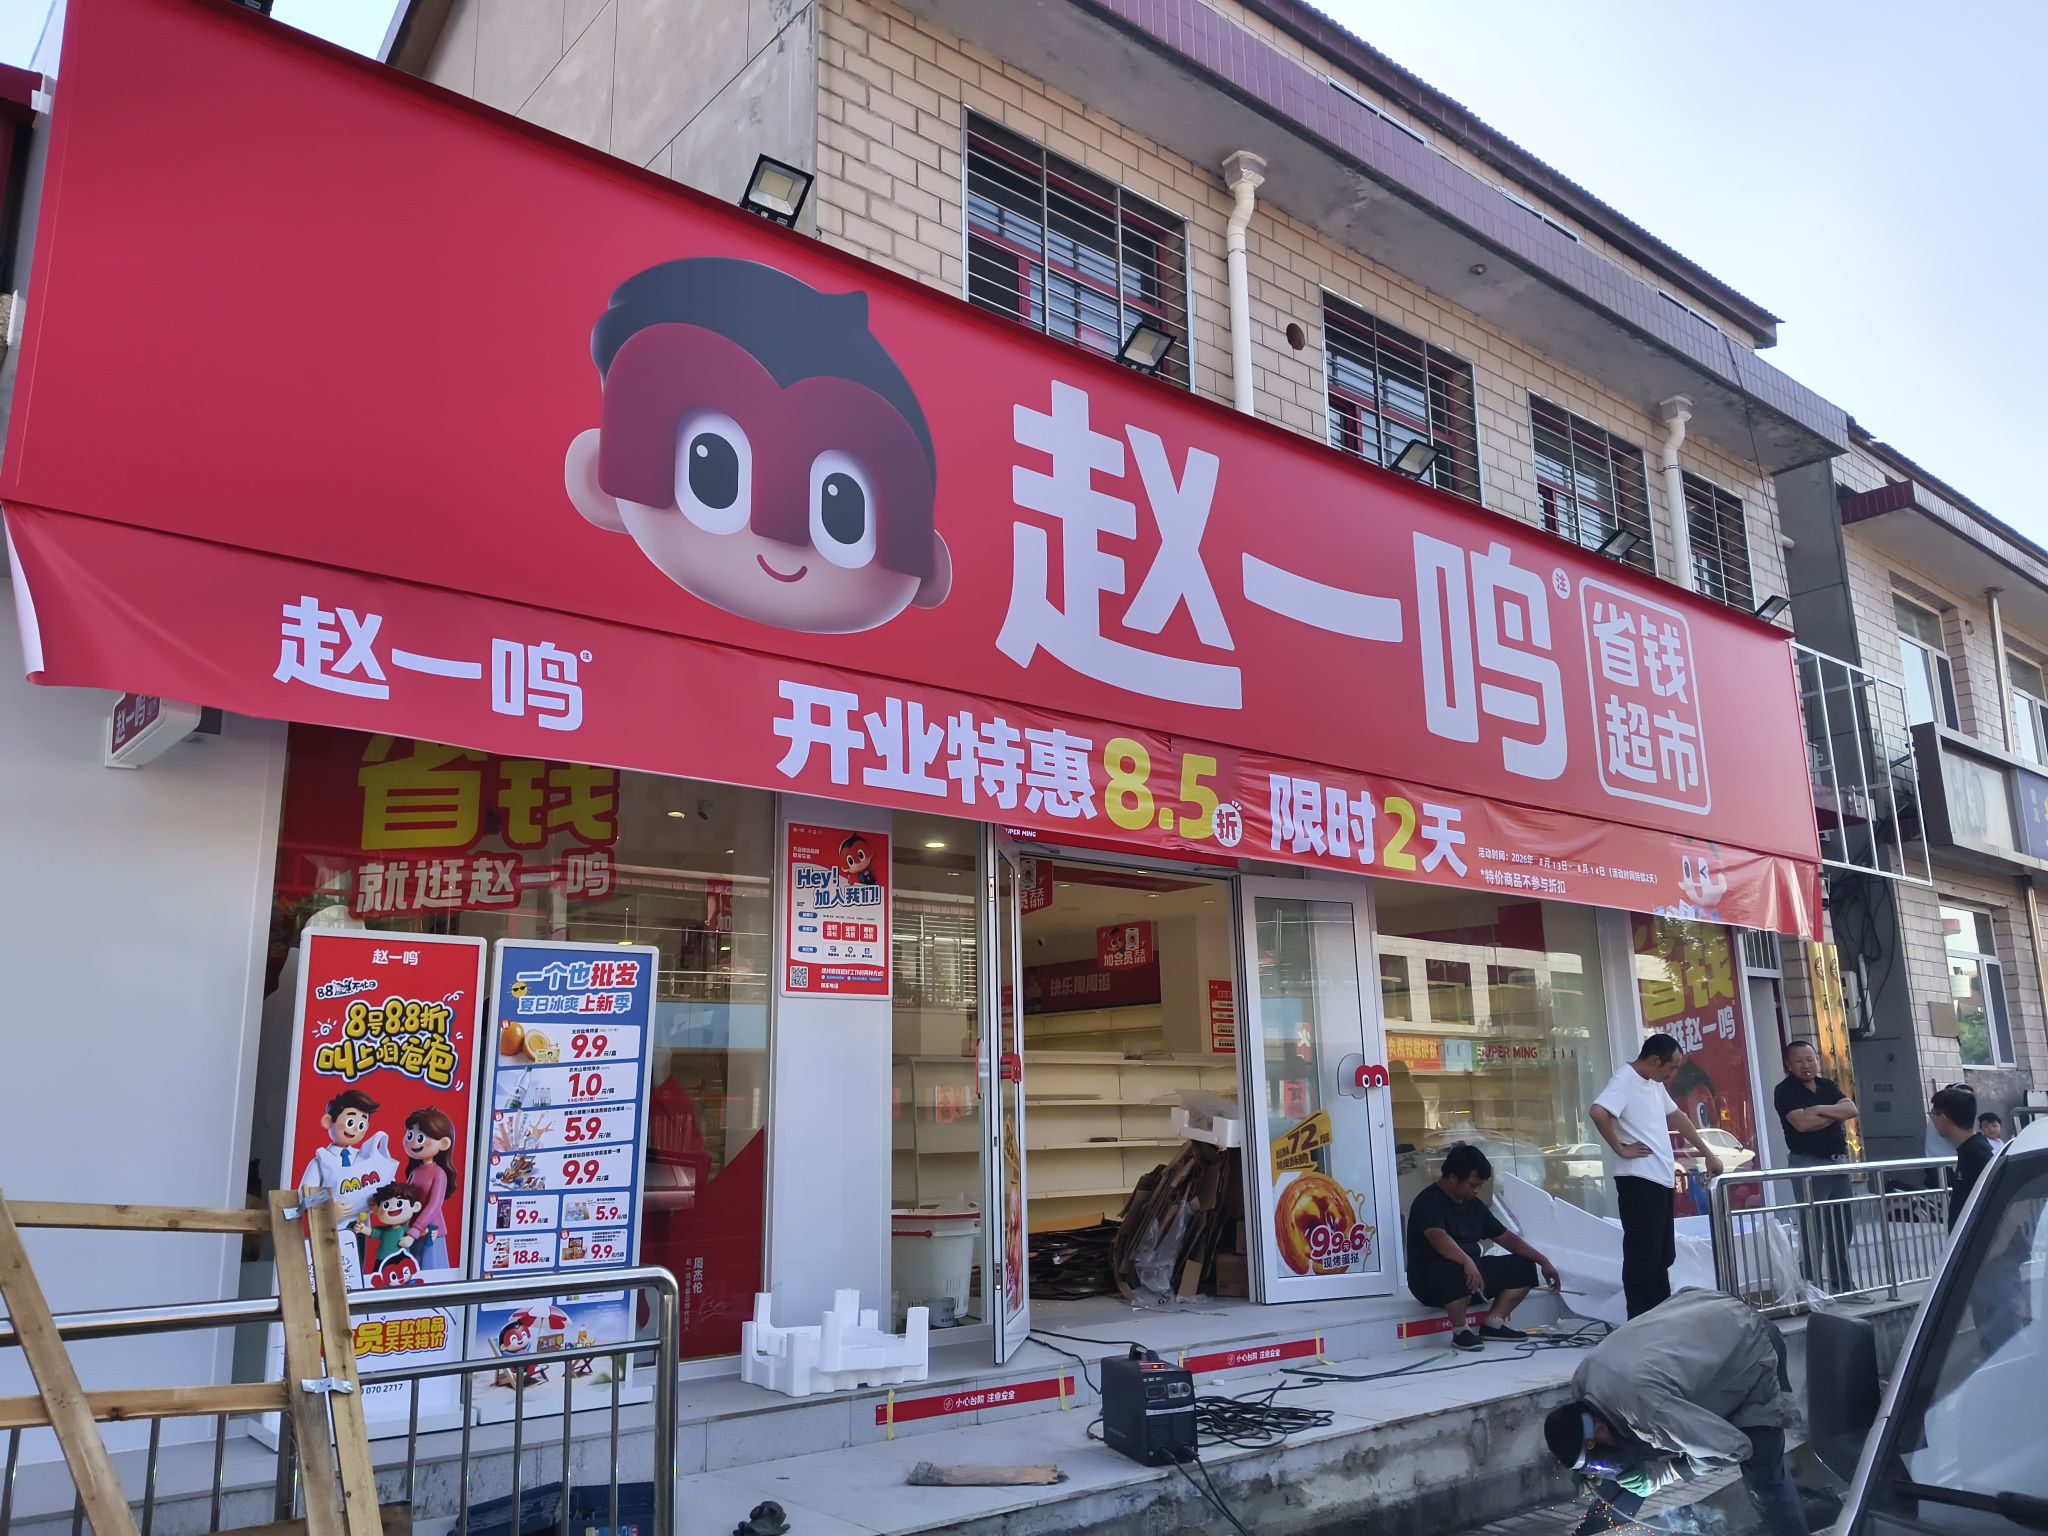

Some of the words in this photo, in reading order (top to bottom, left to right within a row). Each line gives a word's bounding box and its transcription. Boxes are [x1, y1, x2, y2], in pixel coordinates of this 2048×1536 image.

[995, 379, 1568, 781] 赵一鸣
[1593, 601, 1688, 704] 省钱
[114, 694, 146, 746] 赵一鸣
[273, 596, 583, 731] 赵一鸣
[1269, 774, 1468, 878] 限时2天
[1605, 694, 1699, 792] 超市
[358, 733, 614, 850] 省钱
[356, 852, 610, 912] 就逛赵一鸣
[797, 867, 838, 888] Hey!
[372, 948, 419, 966] 赵一鸣
[517, 961, 639, 991] 一个也批发
[1050, 973, 1111, 997] 快乐周周逛
[346, 999, 450, 1038] 8号8.8折
[518, 992, 632, 1015] 夏日冰爽上新季
[1646, 1005, 1736, 1056] 逛赵一鸣
[317, 1034, 455, 1085] 叫上咱爸爸
[1513, 1046, 1538, 1059] MING
[693, 1257, 703, 1294] 周杰伦
[1323, 1252, 1360, 1269] 现烤蛋挞
[385, 1332, 444, 1353] 天天特价
[366, 1386, 381, 1395] 070
[383, 1383, 403, 1393] 2717
[956, 1396, 984, 1408] 小心台阶
[987, 1390, 1015, 1403] 注意安全
